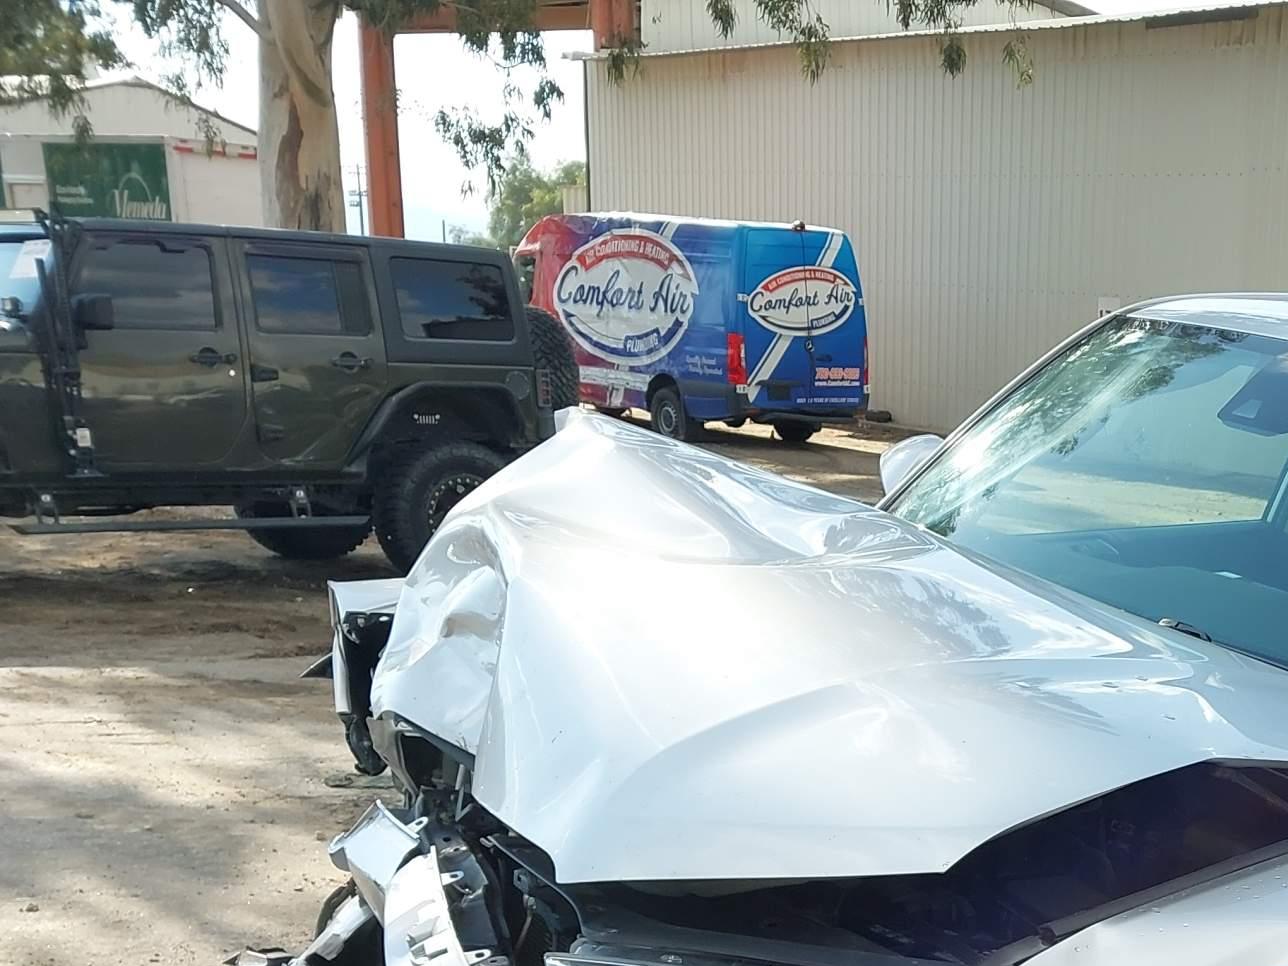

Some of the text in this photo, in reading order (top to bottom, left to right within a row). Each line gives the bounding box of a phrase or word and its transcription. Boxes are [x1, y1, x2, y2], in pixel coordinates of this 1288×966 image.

[557, 265, 690, 317] Comfort Air
[750, 284, 852, 314] Comfort Air
